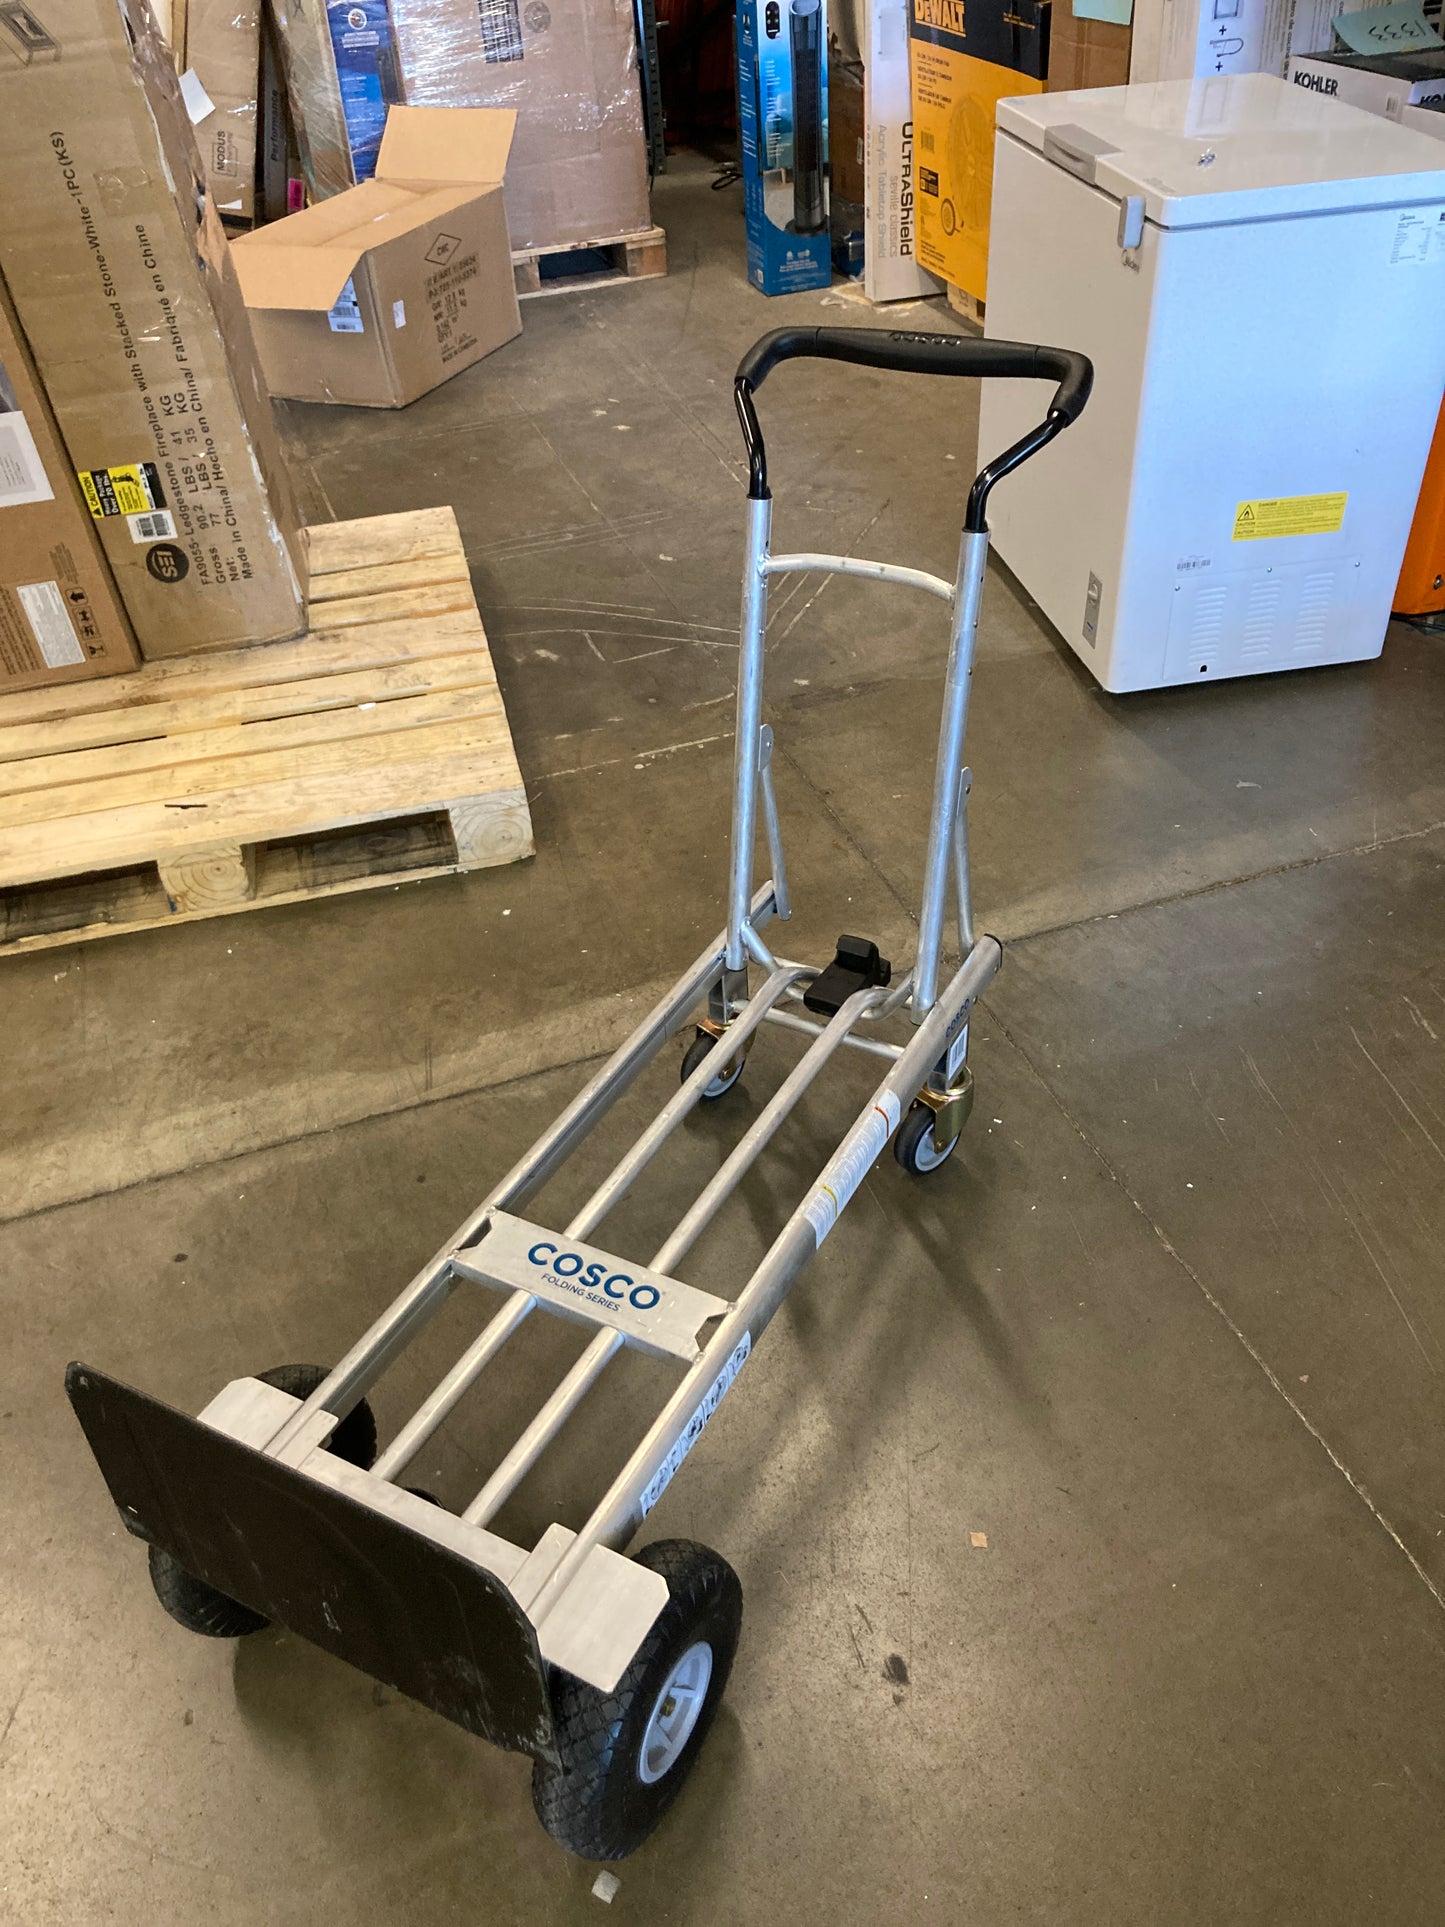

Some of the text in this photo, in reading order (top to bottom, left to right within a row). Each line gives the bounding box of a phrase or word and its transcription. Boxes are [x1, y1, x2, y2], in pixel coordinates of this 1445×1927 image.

[915, 0, 965, 34] DEWALT
[1293, 70, 1339, 97] KOHLER
[216, 131, 226, 171] MODUS
[877, 125, 888, 258] Acrylic Tabletop Shield
[889, 176, 898, 258] seville classics
[135, 224, 157, 270] Chine
[152, 273, 165, 293] en
[109, 302, 137, 359] Stacked
[131, 364, 148, 392] with
[180, 367, 203, 412] China/
[160, 395, 175, 417] KG
[174, 392, 189, 414] KG
[143, 396, 170, 458] Fireplace
[170, 430, 183, 445] 41
[184, 427, 198, 443] 35
[198, 416, 210, 433] en
[205, 438, 224, 481] Hecho
[82, 476, 98, 507] CAUTION
[181, 466, 199, 494] LBS
[195, 463, 213, 491] LBS
[193, 504, 209, 530] 90.2
[209, 513, 222, 527] 77
[216, 484, 237, 527] China/
[156, 549, 179, 578] SEI
[226, 556, 241, 582] Net:
[237, 546, 253, 579] Made
[527, 1242, 661, 1310] COSCO
[541, 1272, 621, 1312] FOLDING SERIES
